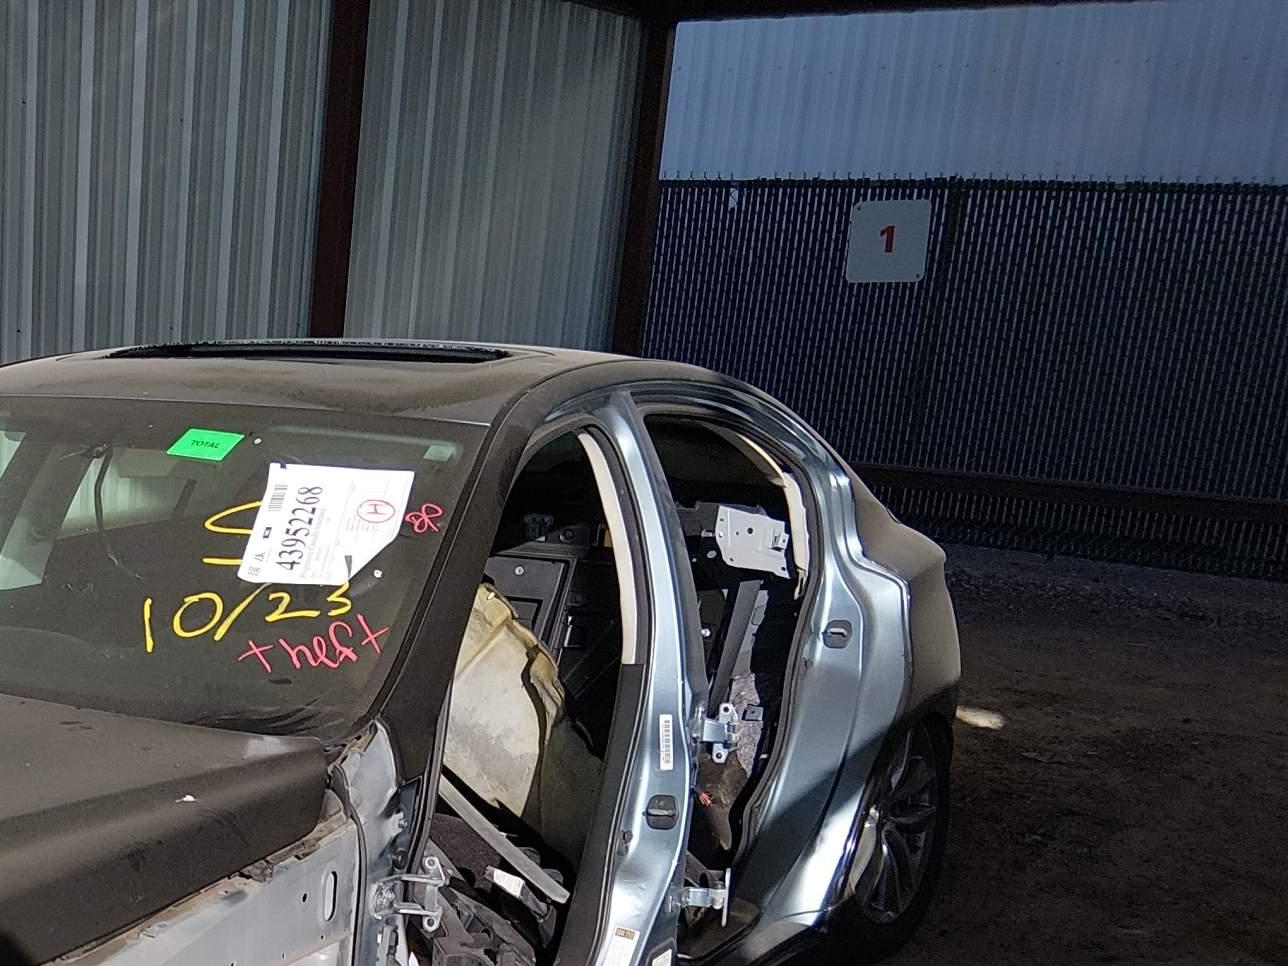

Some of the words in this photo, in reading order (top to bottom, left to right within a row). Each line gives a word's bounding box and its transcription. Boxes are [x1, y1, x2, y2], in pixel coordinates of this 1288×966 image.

[880, 225, 895, 253] 1
[191, 439, 220, 449] TOTAL
[275, 486, 323, 571] 43952268
[143, 582, 352, 653] 10/23
[237, 613, 390, 673] theft
